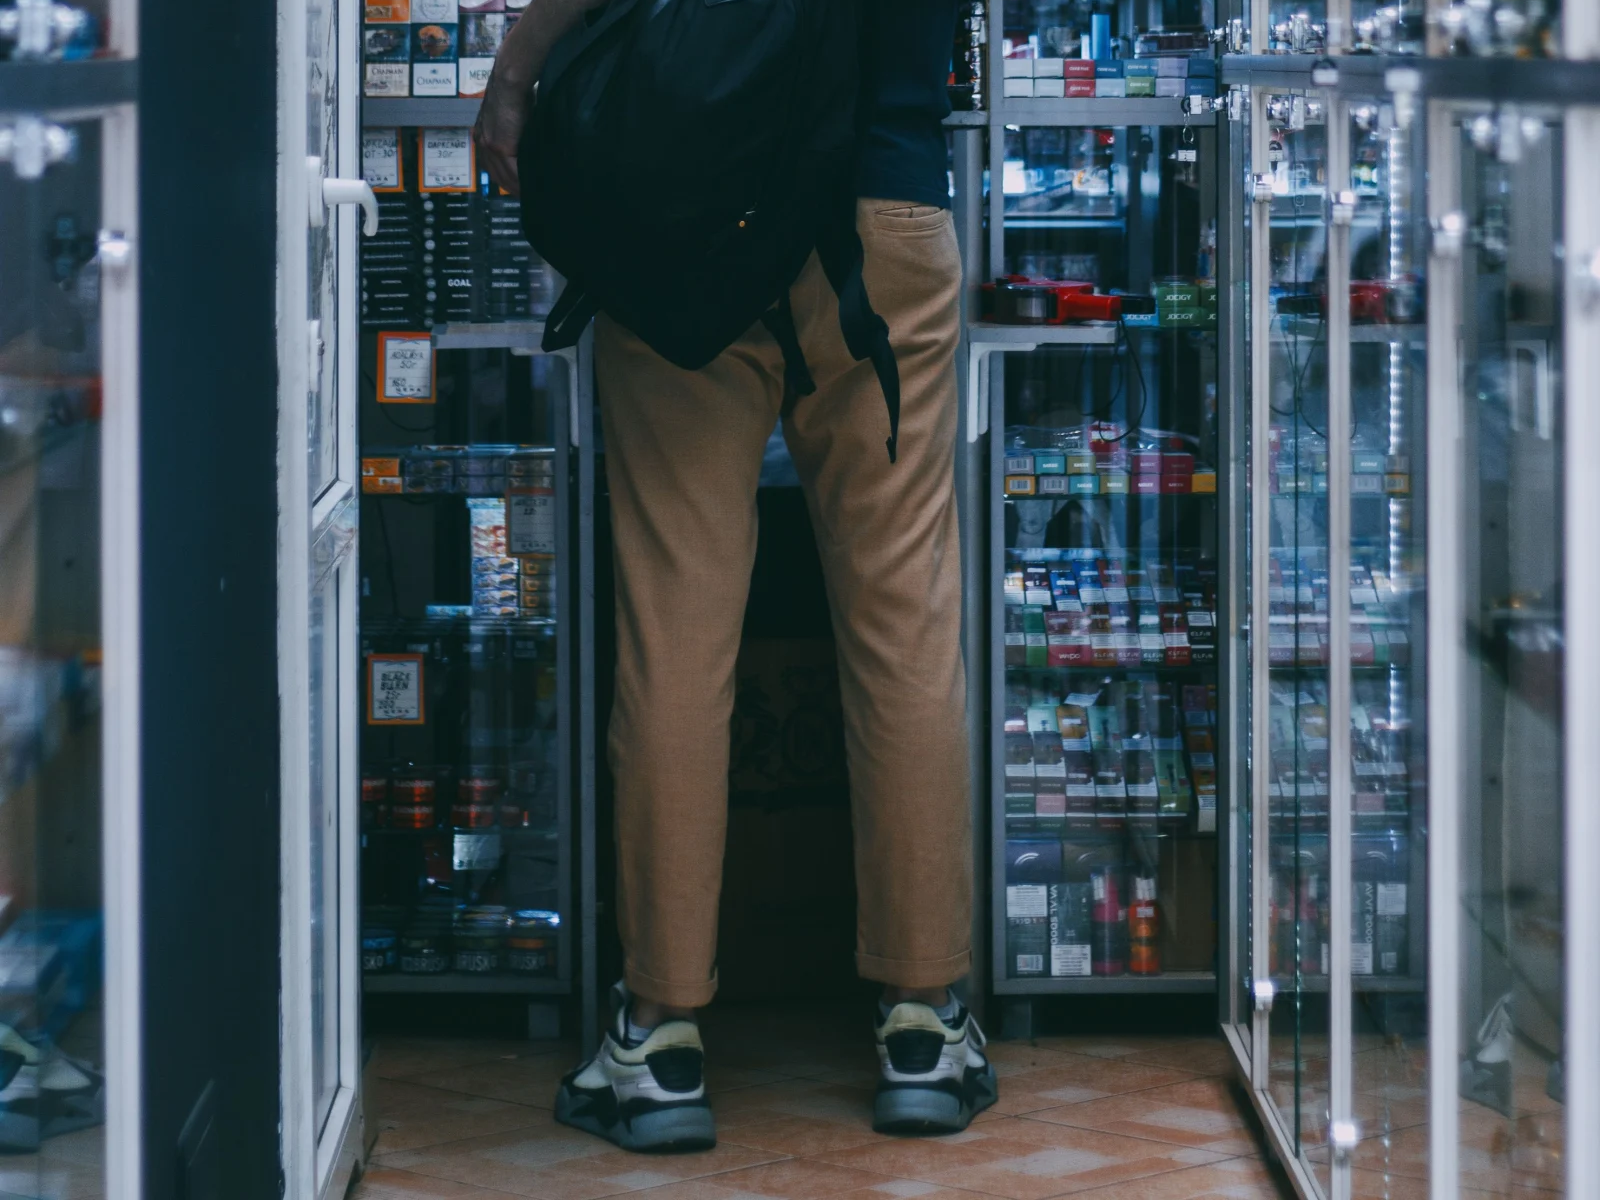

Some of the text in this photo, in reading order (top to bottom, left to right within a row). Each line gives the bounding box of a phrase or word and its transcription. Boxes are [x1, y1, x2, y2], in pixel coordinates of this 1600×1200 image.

[469, 70, 492, 80] MERC
[416, 76, 452, 86] CHAPMAN
[447, 279, 472, 287] GOAL
